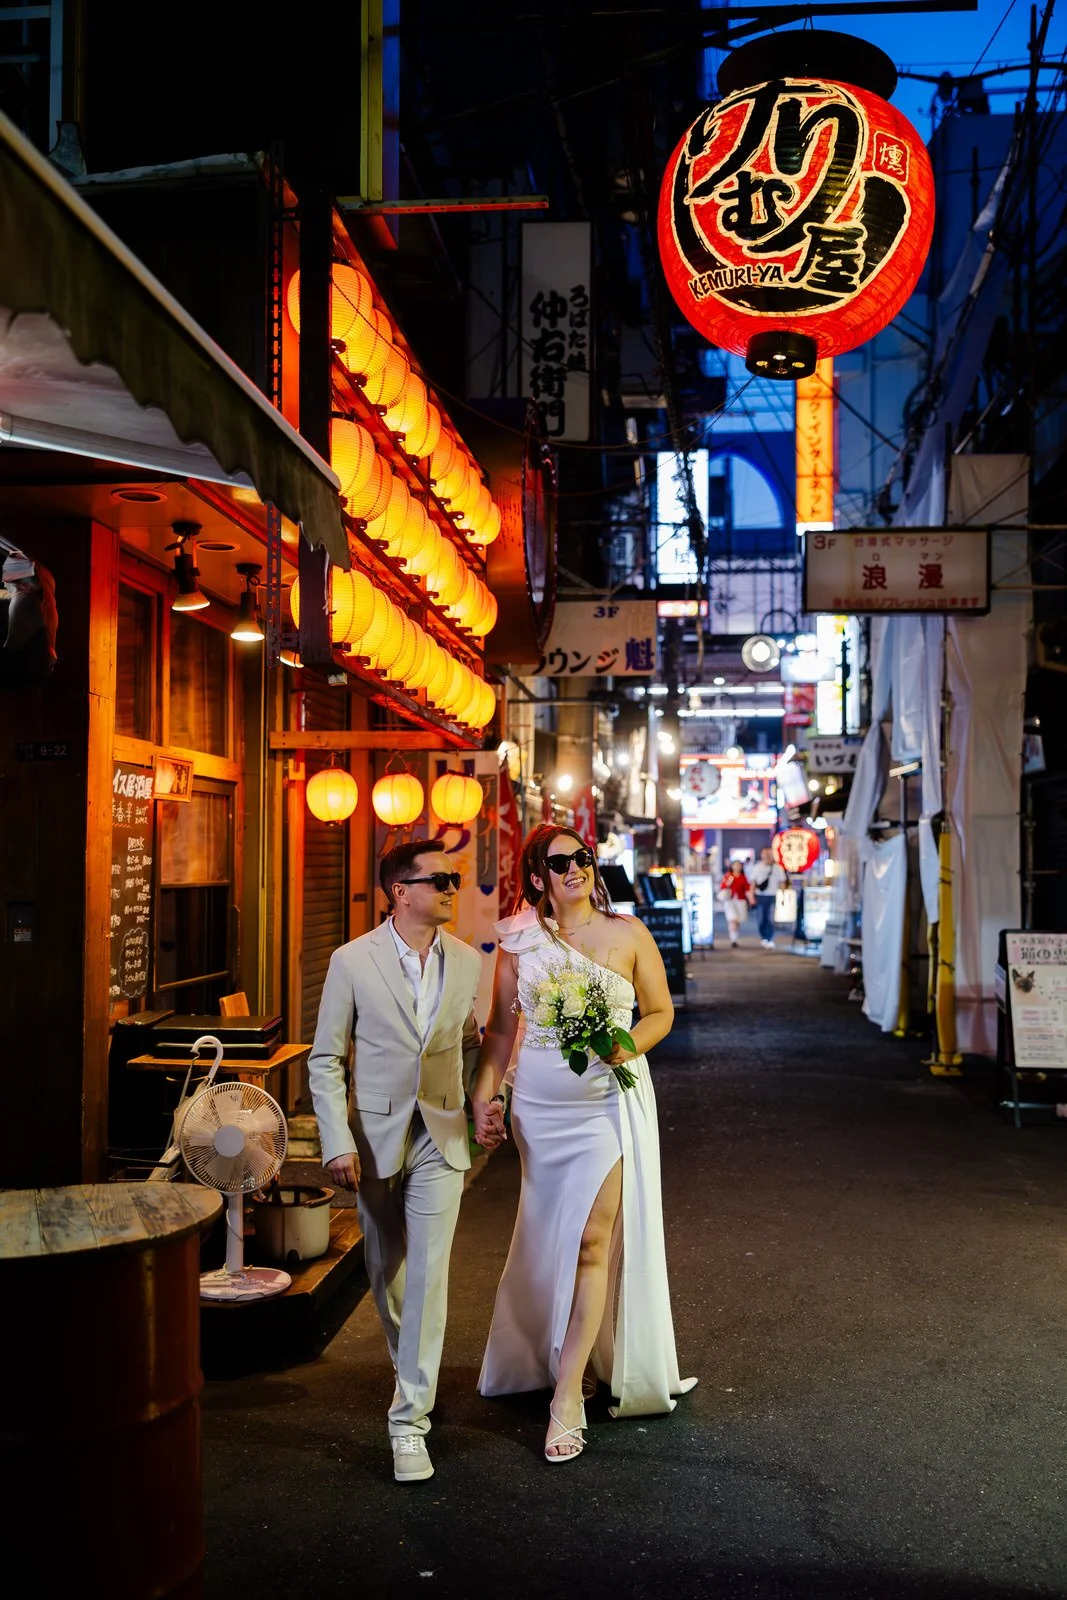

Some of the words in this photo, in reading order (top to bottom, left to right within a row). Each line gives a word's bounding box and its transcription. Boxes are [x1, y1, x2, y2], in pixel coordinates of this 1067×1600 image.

[689, 264, 784, 300] KEMURI-YA
[813, 535, 837, 550] 3F
[593, 606, 620, 619] 3F
[625, 637, 655, 672] 魁
